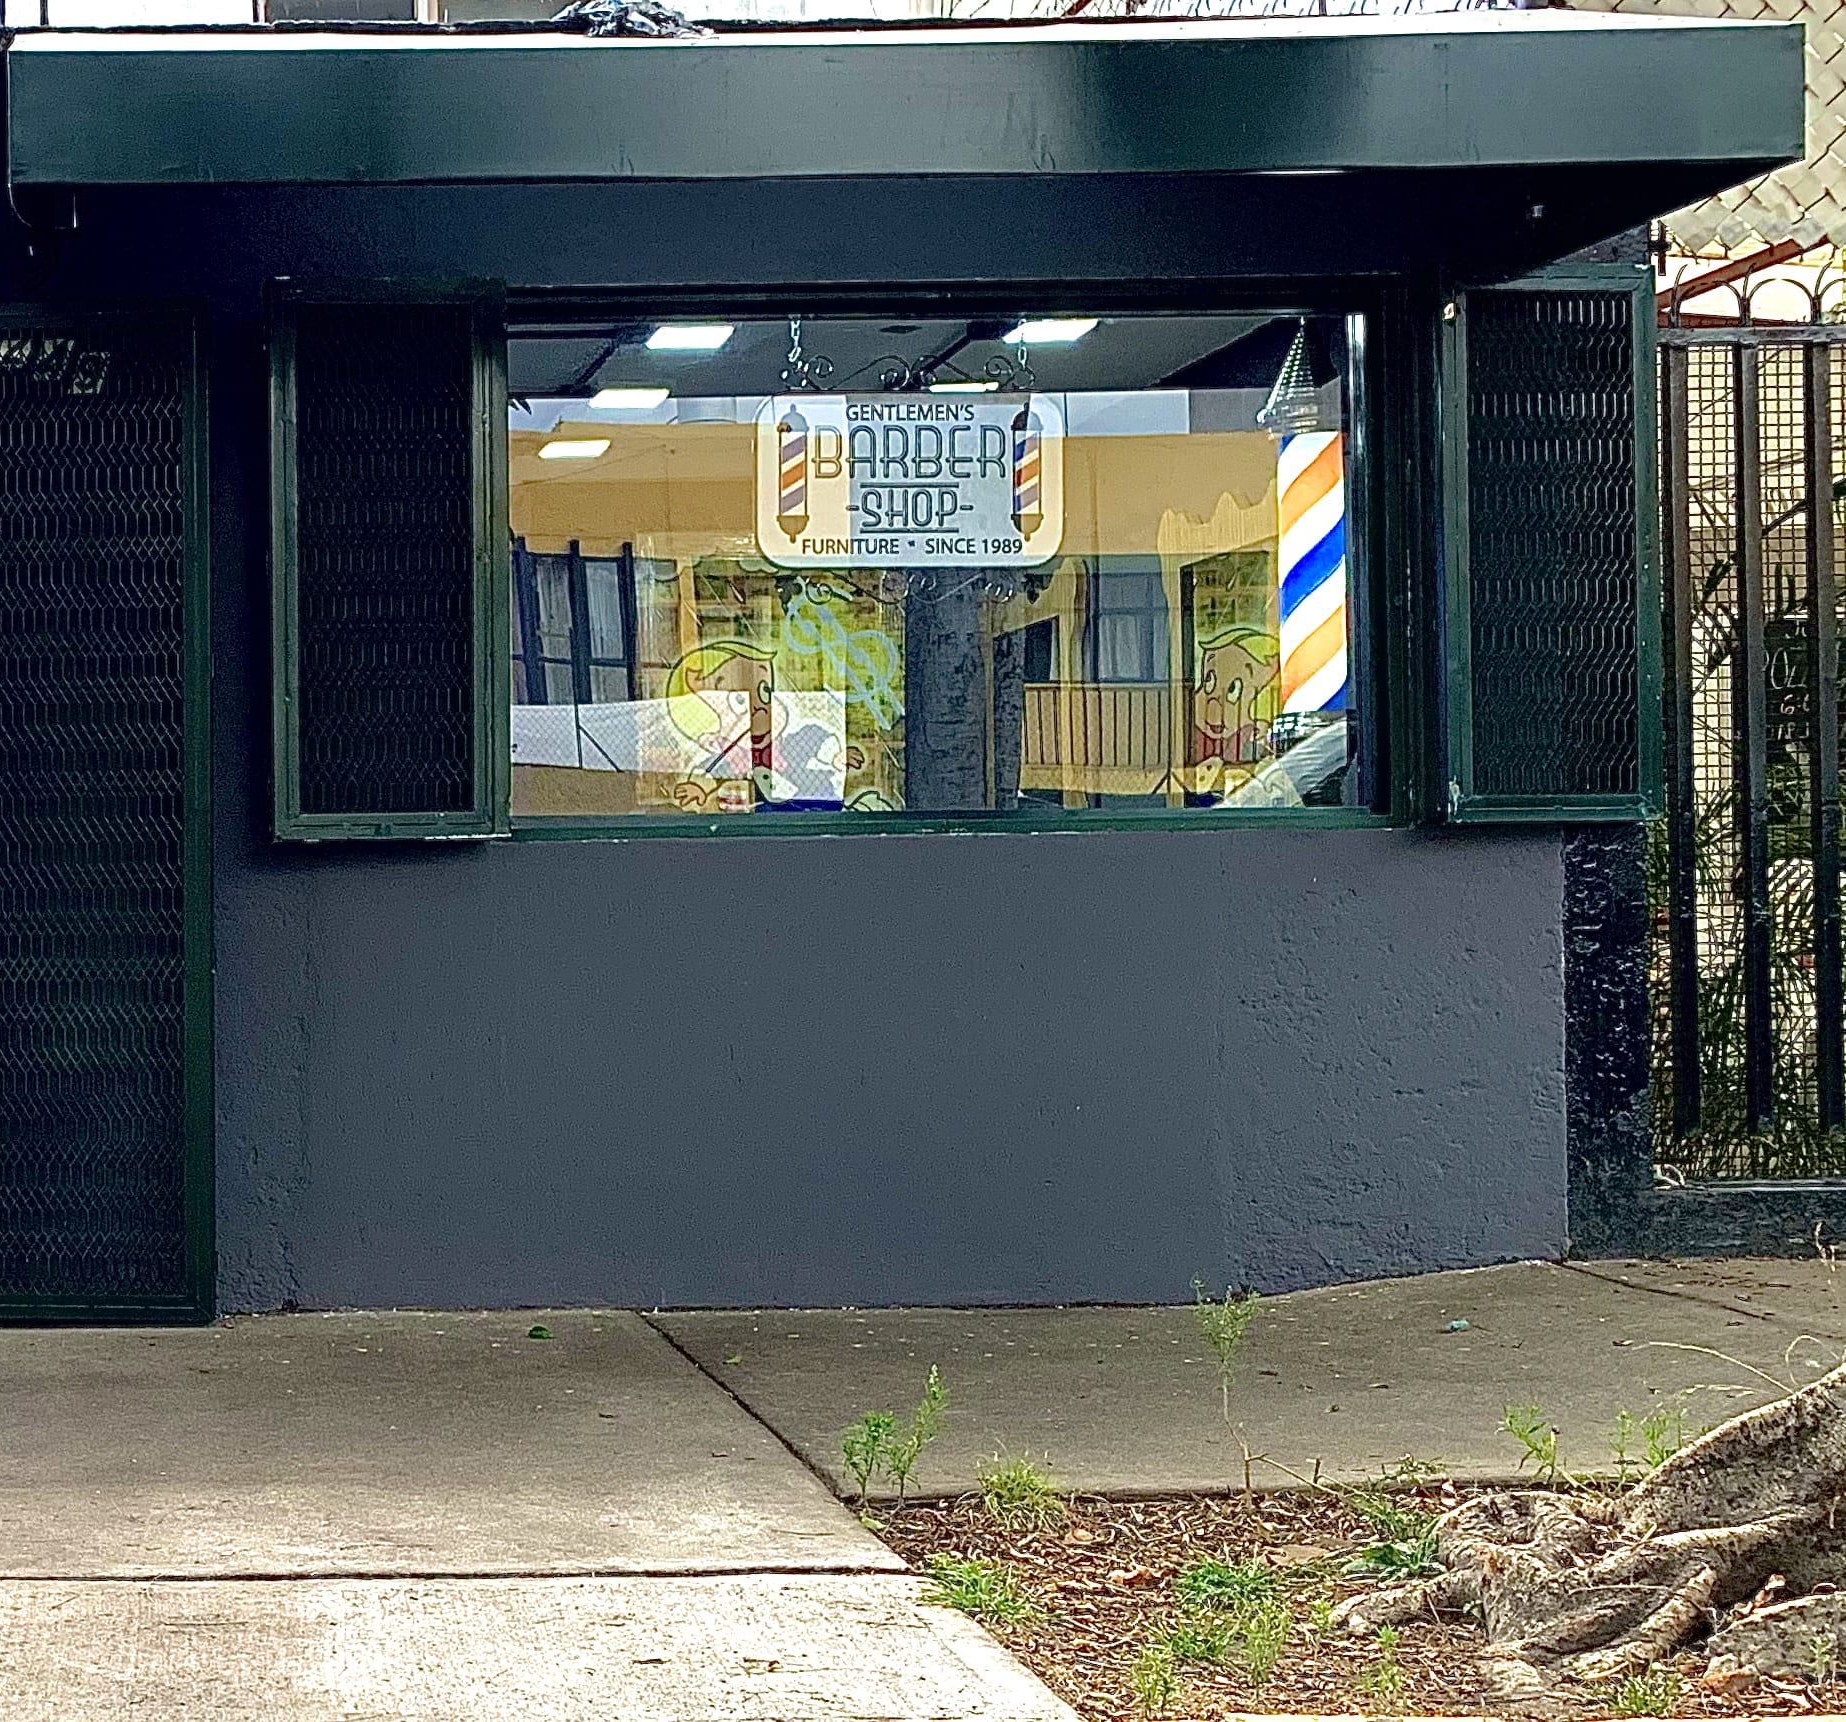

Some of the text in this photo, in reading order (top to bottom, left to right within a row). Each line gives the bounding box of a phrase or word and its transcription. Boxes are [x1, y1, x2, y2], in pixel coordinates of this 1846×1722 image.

[845, 403, 975, 422] GENTLEMEN'S
[812, 424, 1007, 479] BARBER
[801, 538, 1023, 555] FURNITURE SINCE 1989
